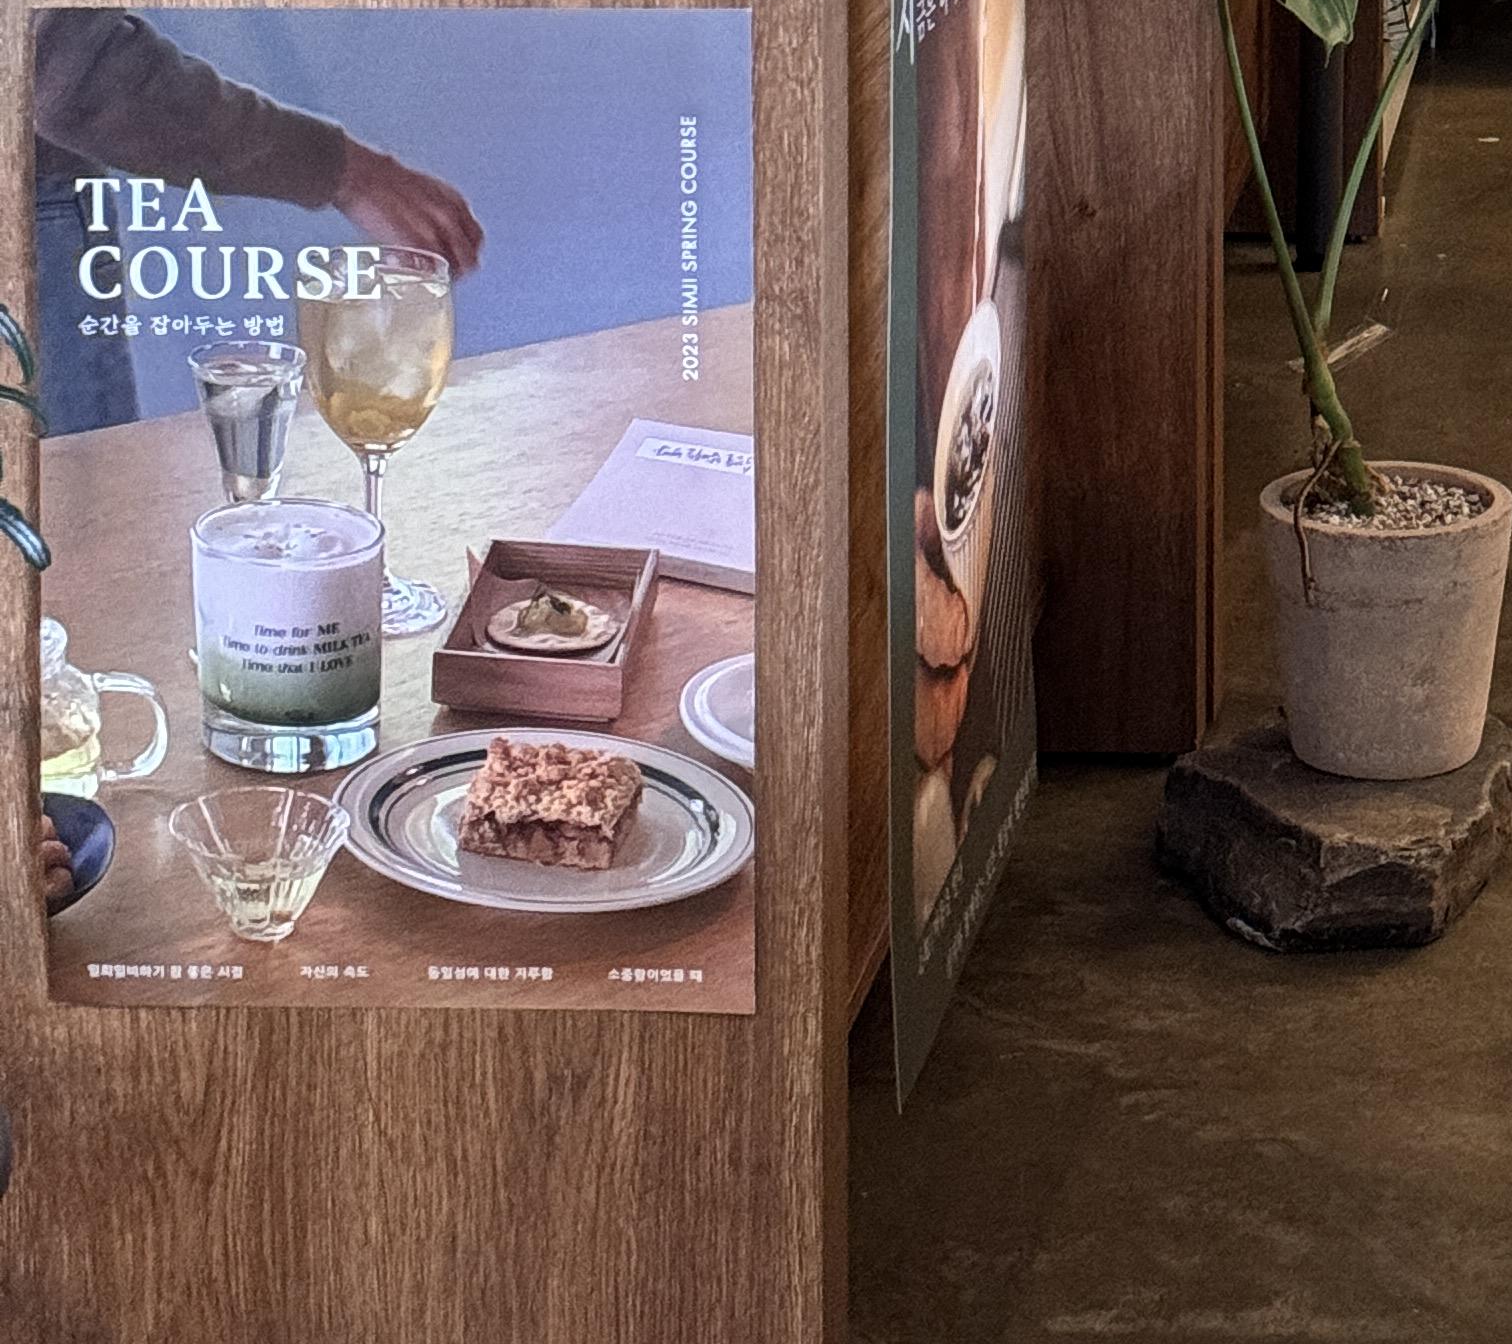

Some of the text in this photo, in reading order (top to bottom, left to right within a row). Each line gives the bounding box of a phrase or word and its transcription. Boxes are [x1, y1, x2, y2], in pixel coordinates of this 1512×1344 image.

[74, 177, 224, 232] TEA
[680, 115, 699, 381] 2023 SIMJI SPRING COURSE
[78, 245, 382, 301] COURSE
[77, 314, 284, 337] 순간을 잡아두는 방법
[254, 622, 340, 638] Time for ME
[223, 634, 250, 652] Time
[254, 643, 268, 655] to
[273, 643, 308, 656] drink
[313, 640, 348, 655] MILK
[242, 658, 274, 673] Time
[277, 660, 304, 673] that
[320, 655, 354, 673] LOVE
[299, 964, 370, 980] 자신의 속도
